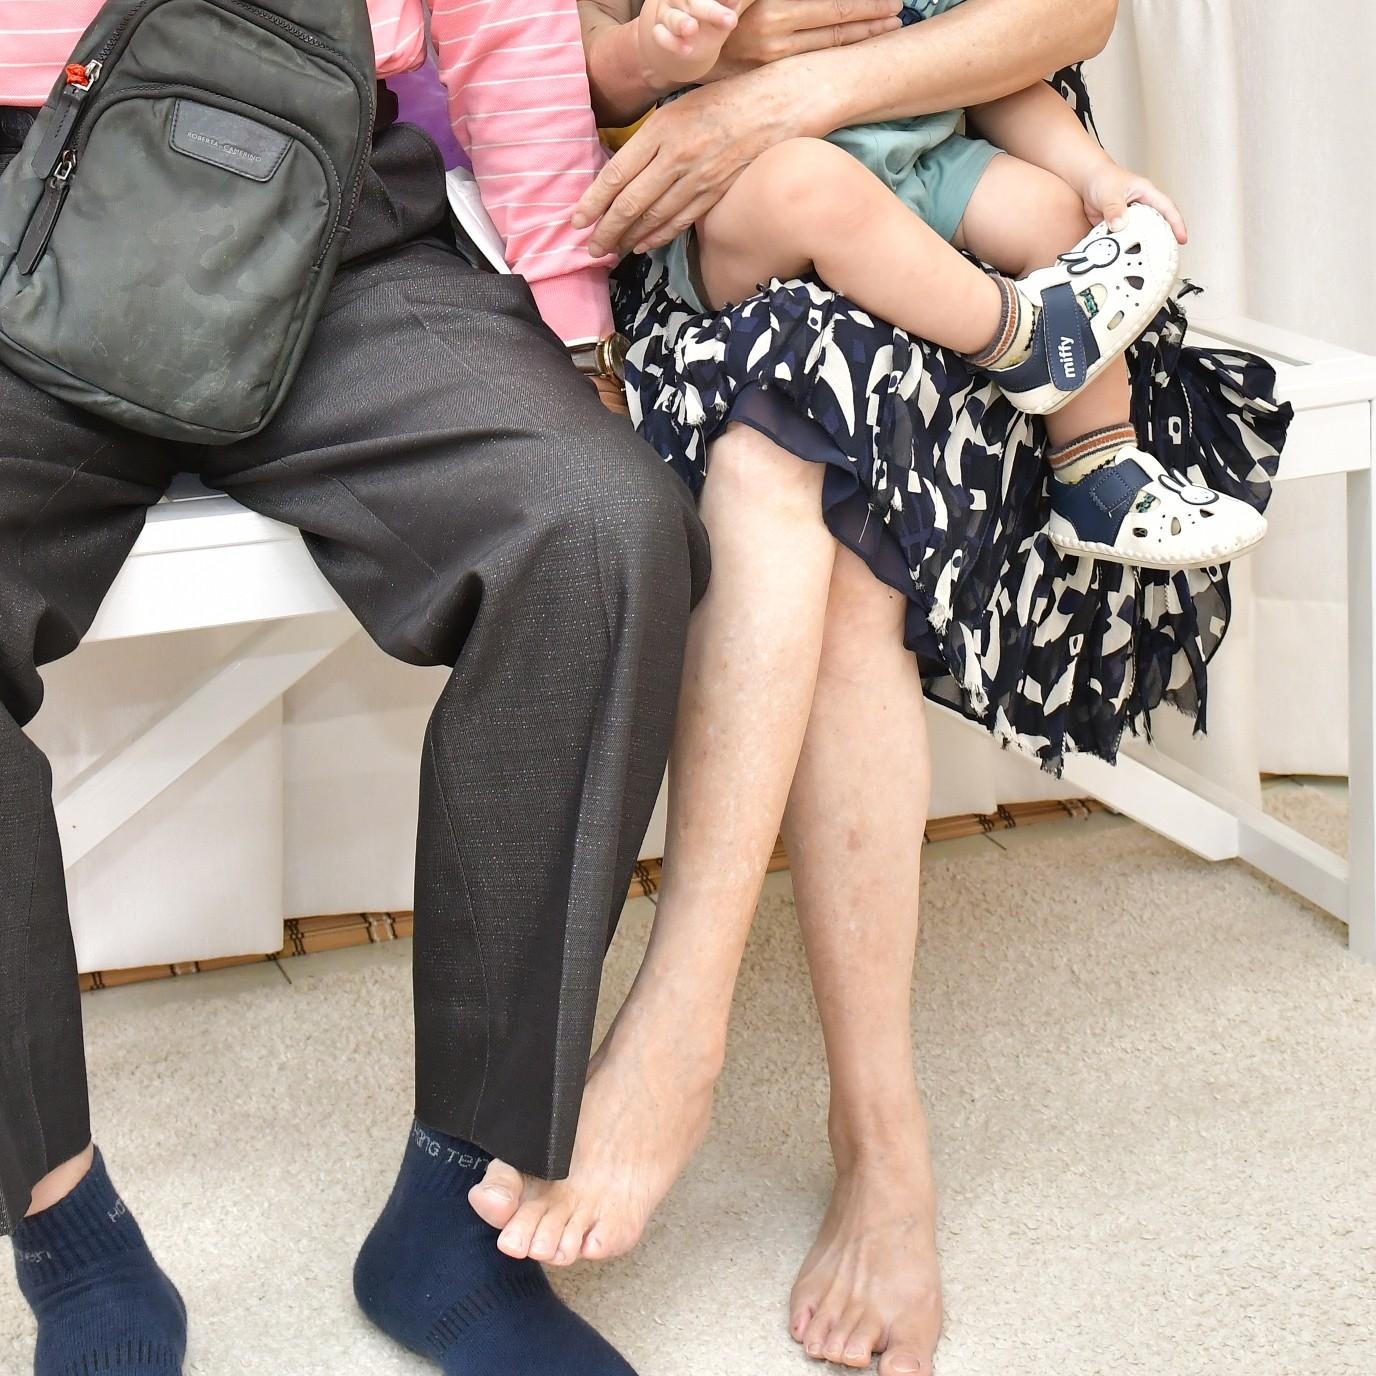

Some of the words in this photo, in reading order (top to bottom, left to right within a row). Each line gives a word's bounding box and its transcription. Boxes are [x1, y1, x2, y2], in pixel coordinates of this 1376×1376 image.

[187, 131, 219, 147] ROBERTA
[223, 144, 262, 162] CAMERINO
[1057, 336, 1076, 378] miffy
